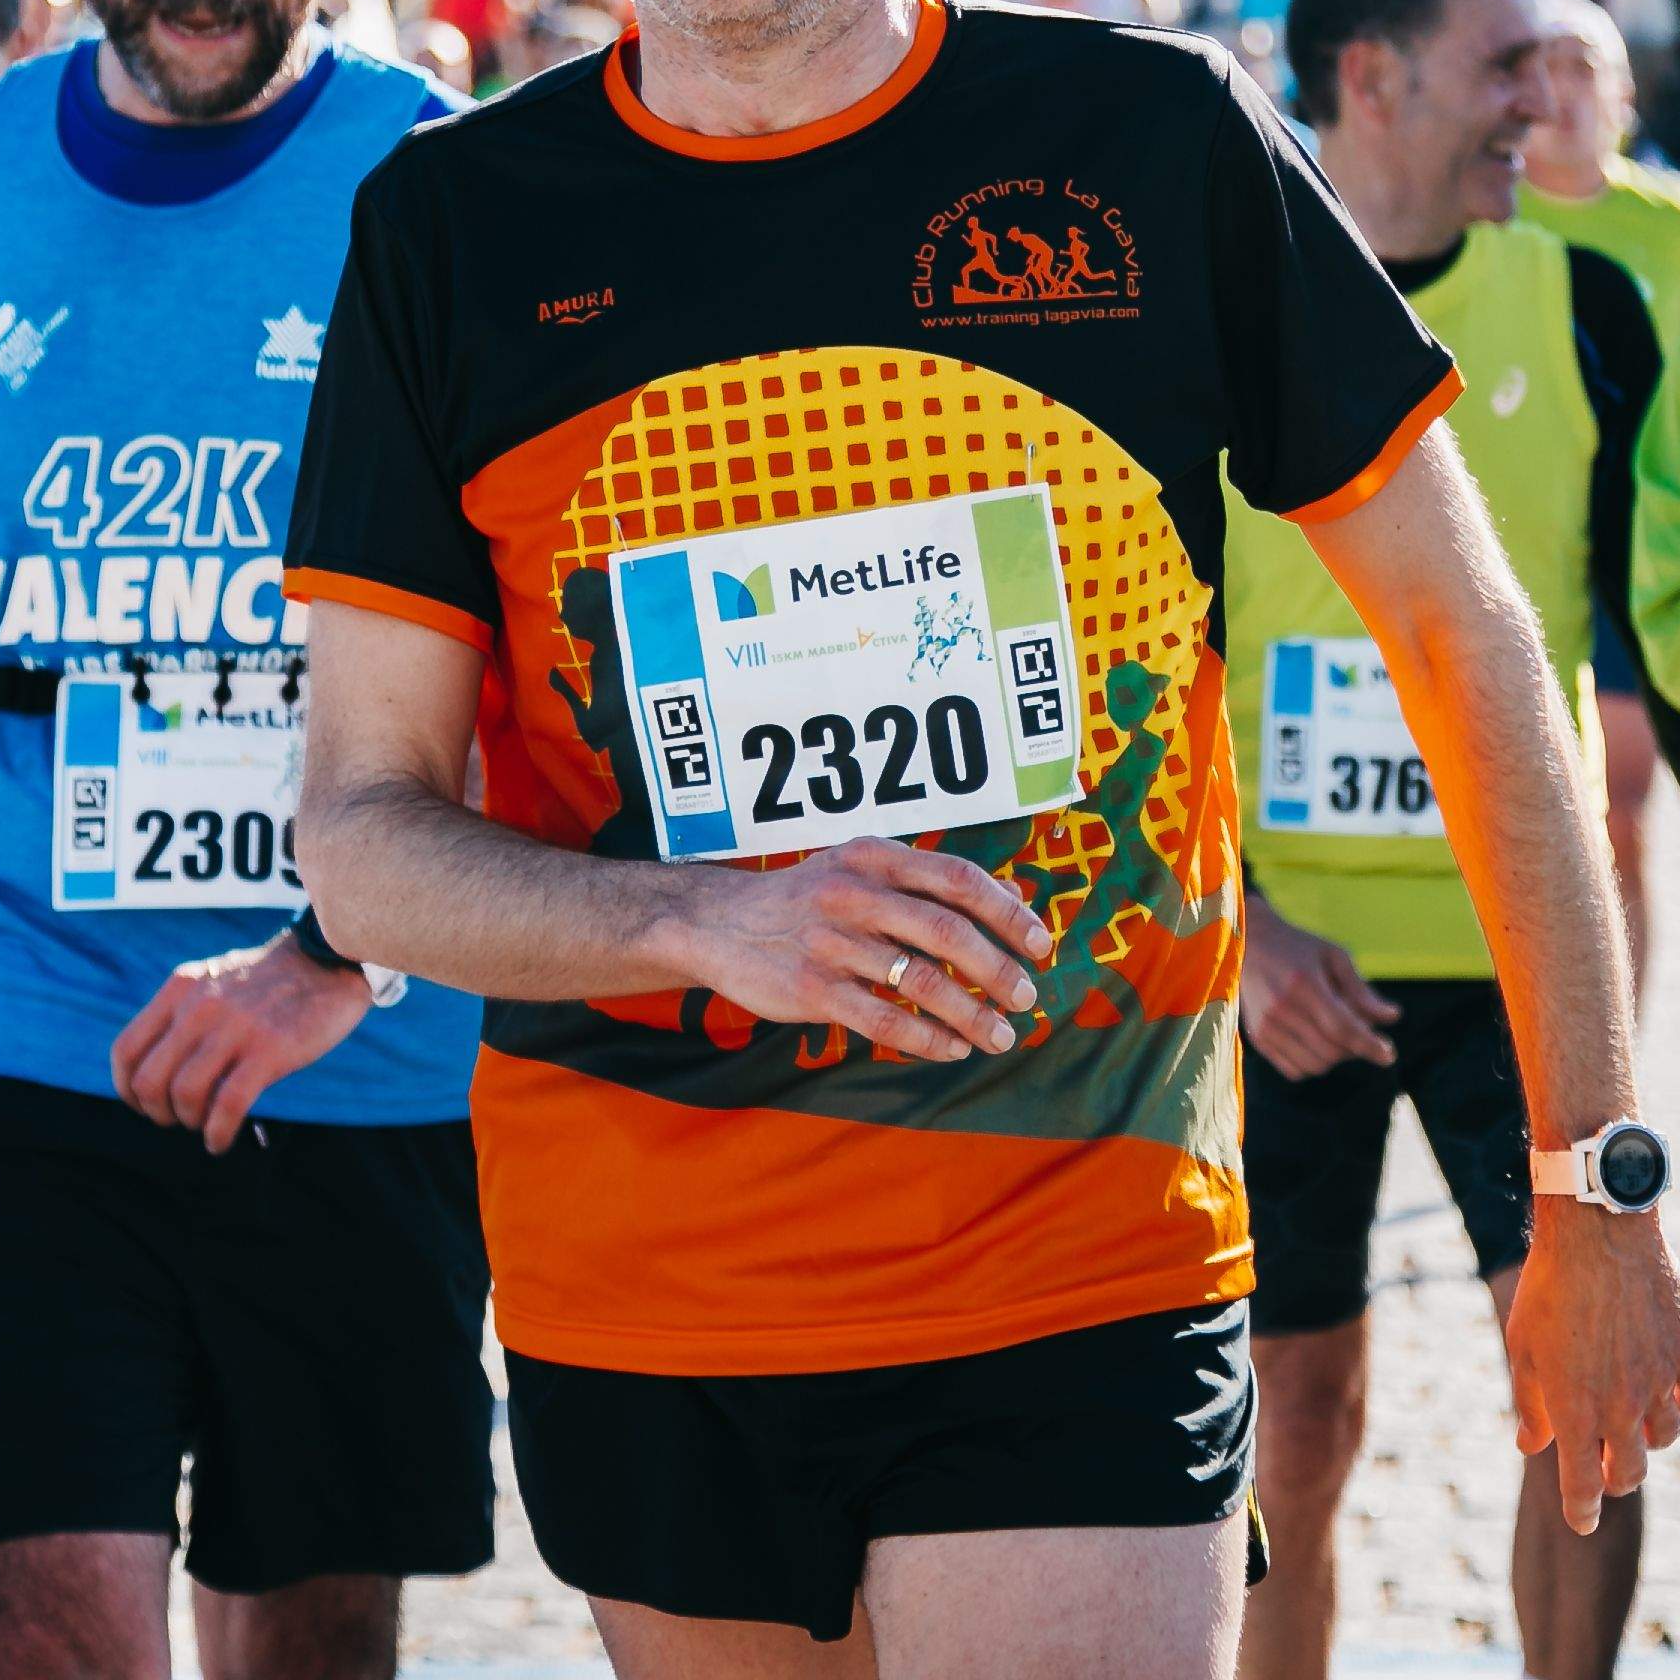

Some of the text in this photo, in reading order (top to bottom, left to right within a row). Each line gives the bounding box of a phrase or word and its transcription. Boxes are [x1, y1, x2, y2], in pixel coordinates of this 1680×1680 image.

[912, 177, 1144, 309] Club Running La Gavia
[538, 287, 615, 322] AMURA
[22, 434, 283, 550] 42K
[789, 544, 962, 603] MetLife
[725, 640, 768, 669] VIII
[770, 649, 805, 666] 15KM
[807, 640, 858, 659] MADRID
[740, 693, 990, 825] 2320
[1329, 753, 1430, 814] 376
